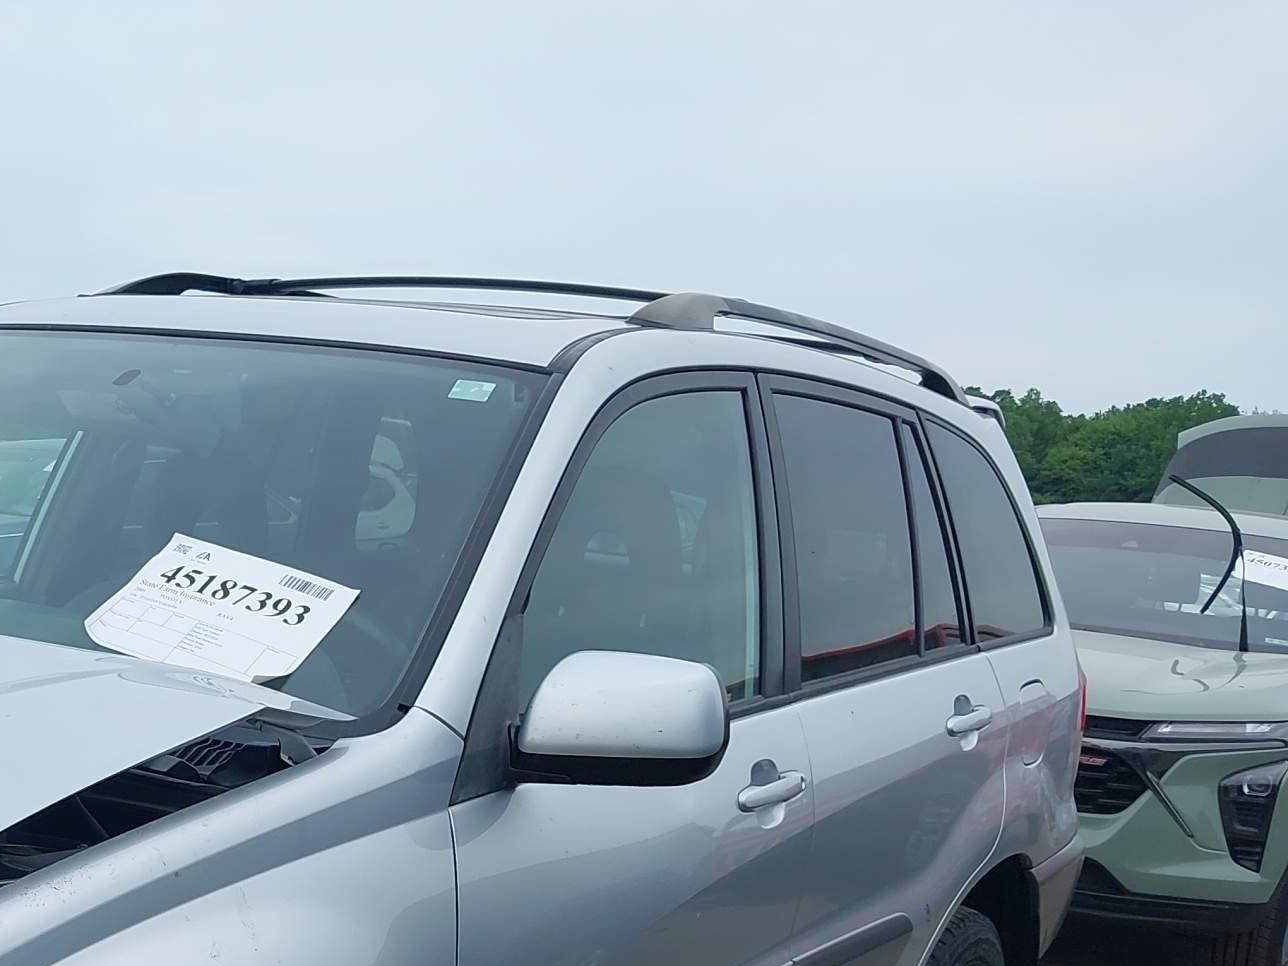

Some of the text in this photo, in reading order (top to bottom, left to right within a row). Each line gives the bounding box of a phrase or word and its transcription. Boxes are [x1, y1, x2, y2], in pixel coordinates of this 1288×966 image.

[159, 583, 179, 595] Farm
[179, 590, 216, 607] Insurance
[160, 565, 311, 625] 45187393
